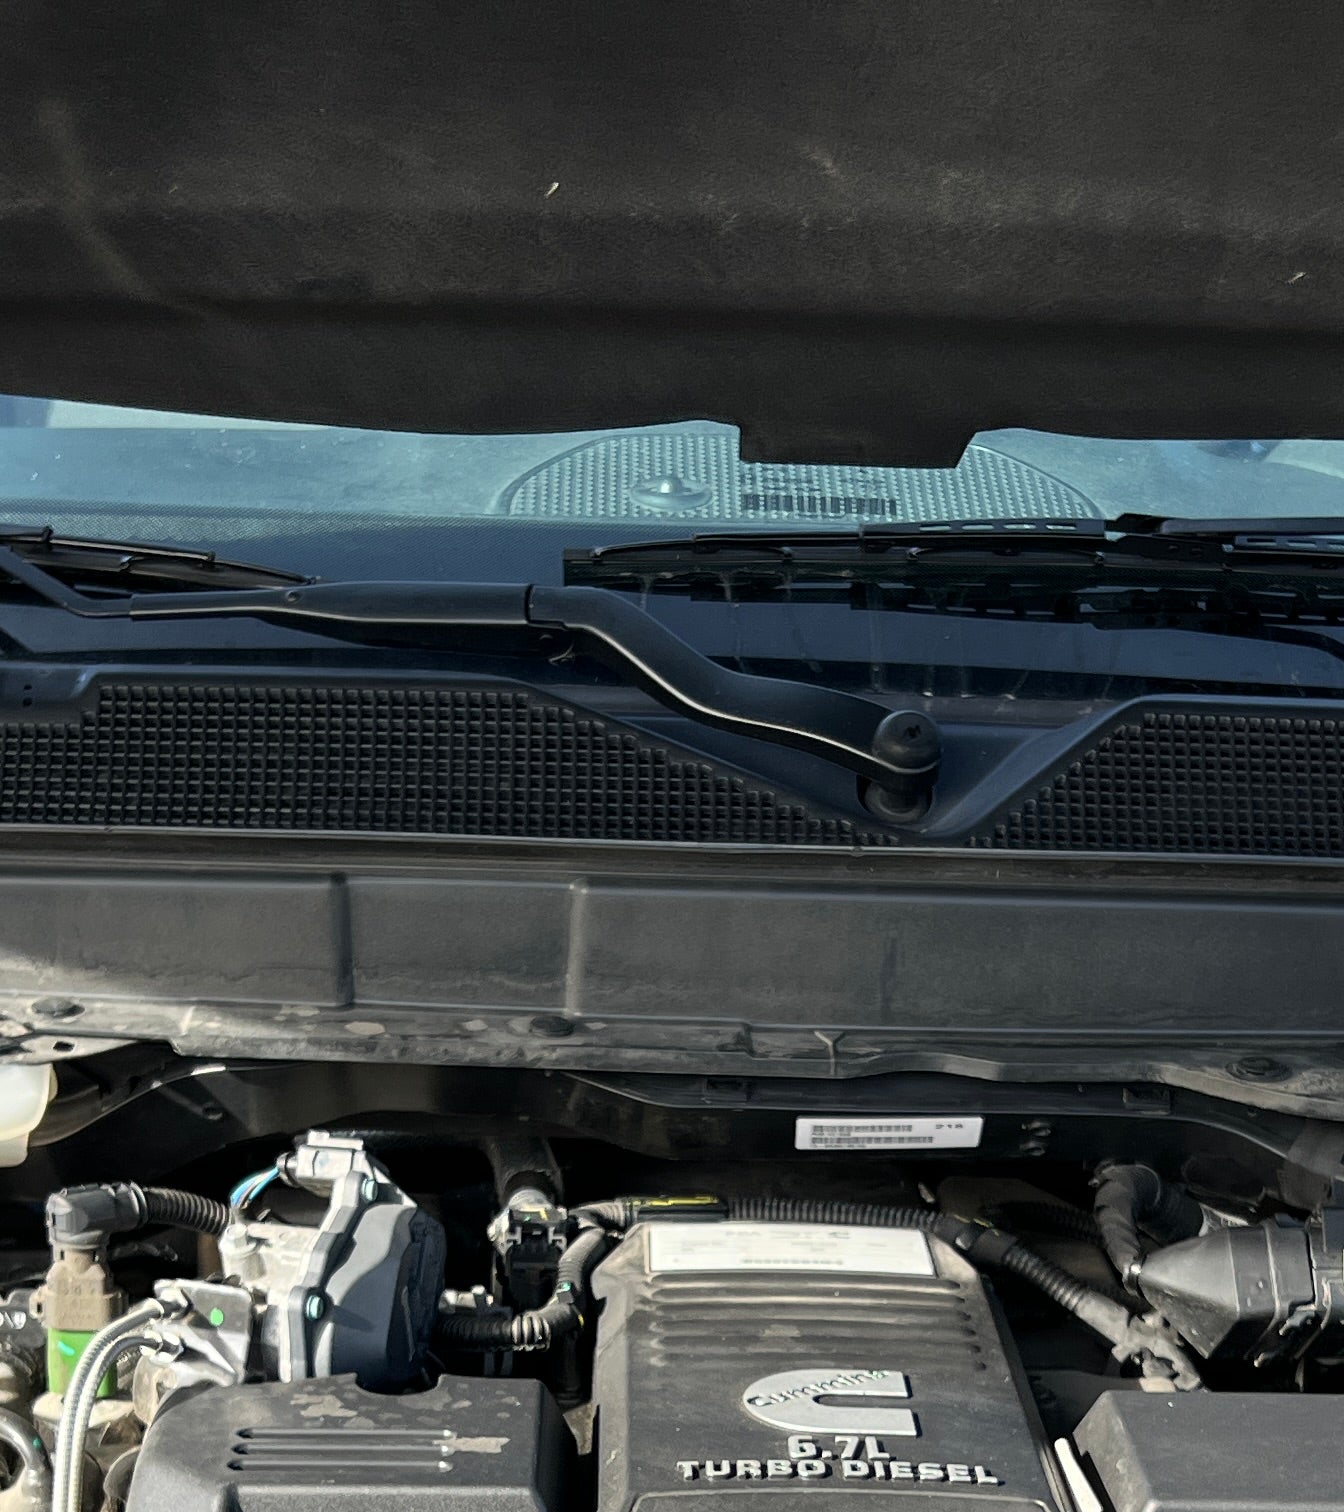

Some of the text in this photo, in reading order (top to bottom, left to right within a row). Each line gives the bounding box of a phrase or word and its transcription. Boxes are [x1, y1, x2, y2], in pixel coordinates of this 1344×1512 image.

[786, 1433, 893, 1462] 6.7L
[676, 1458, 1002, 1486] TURBO DIESEL
